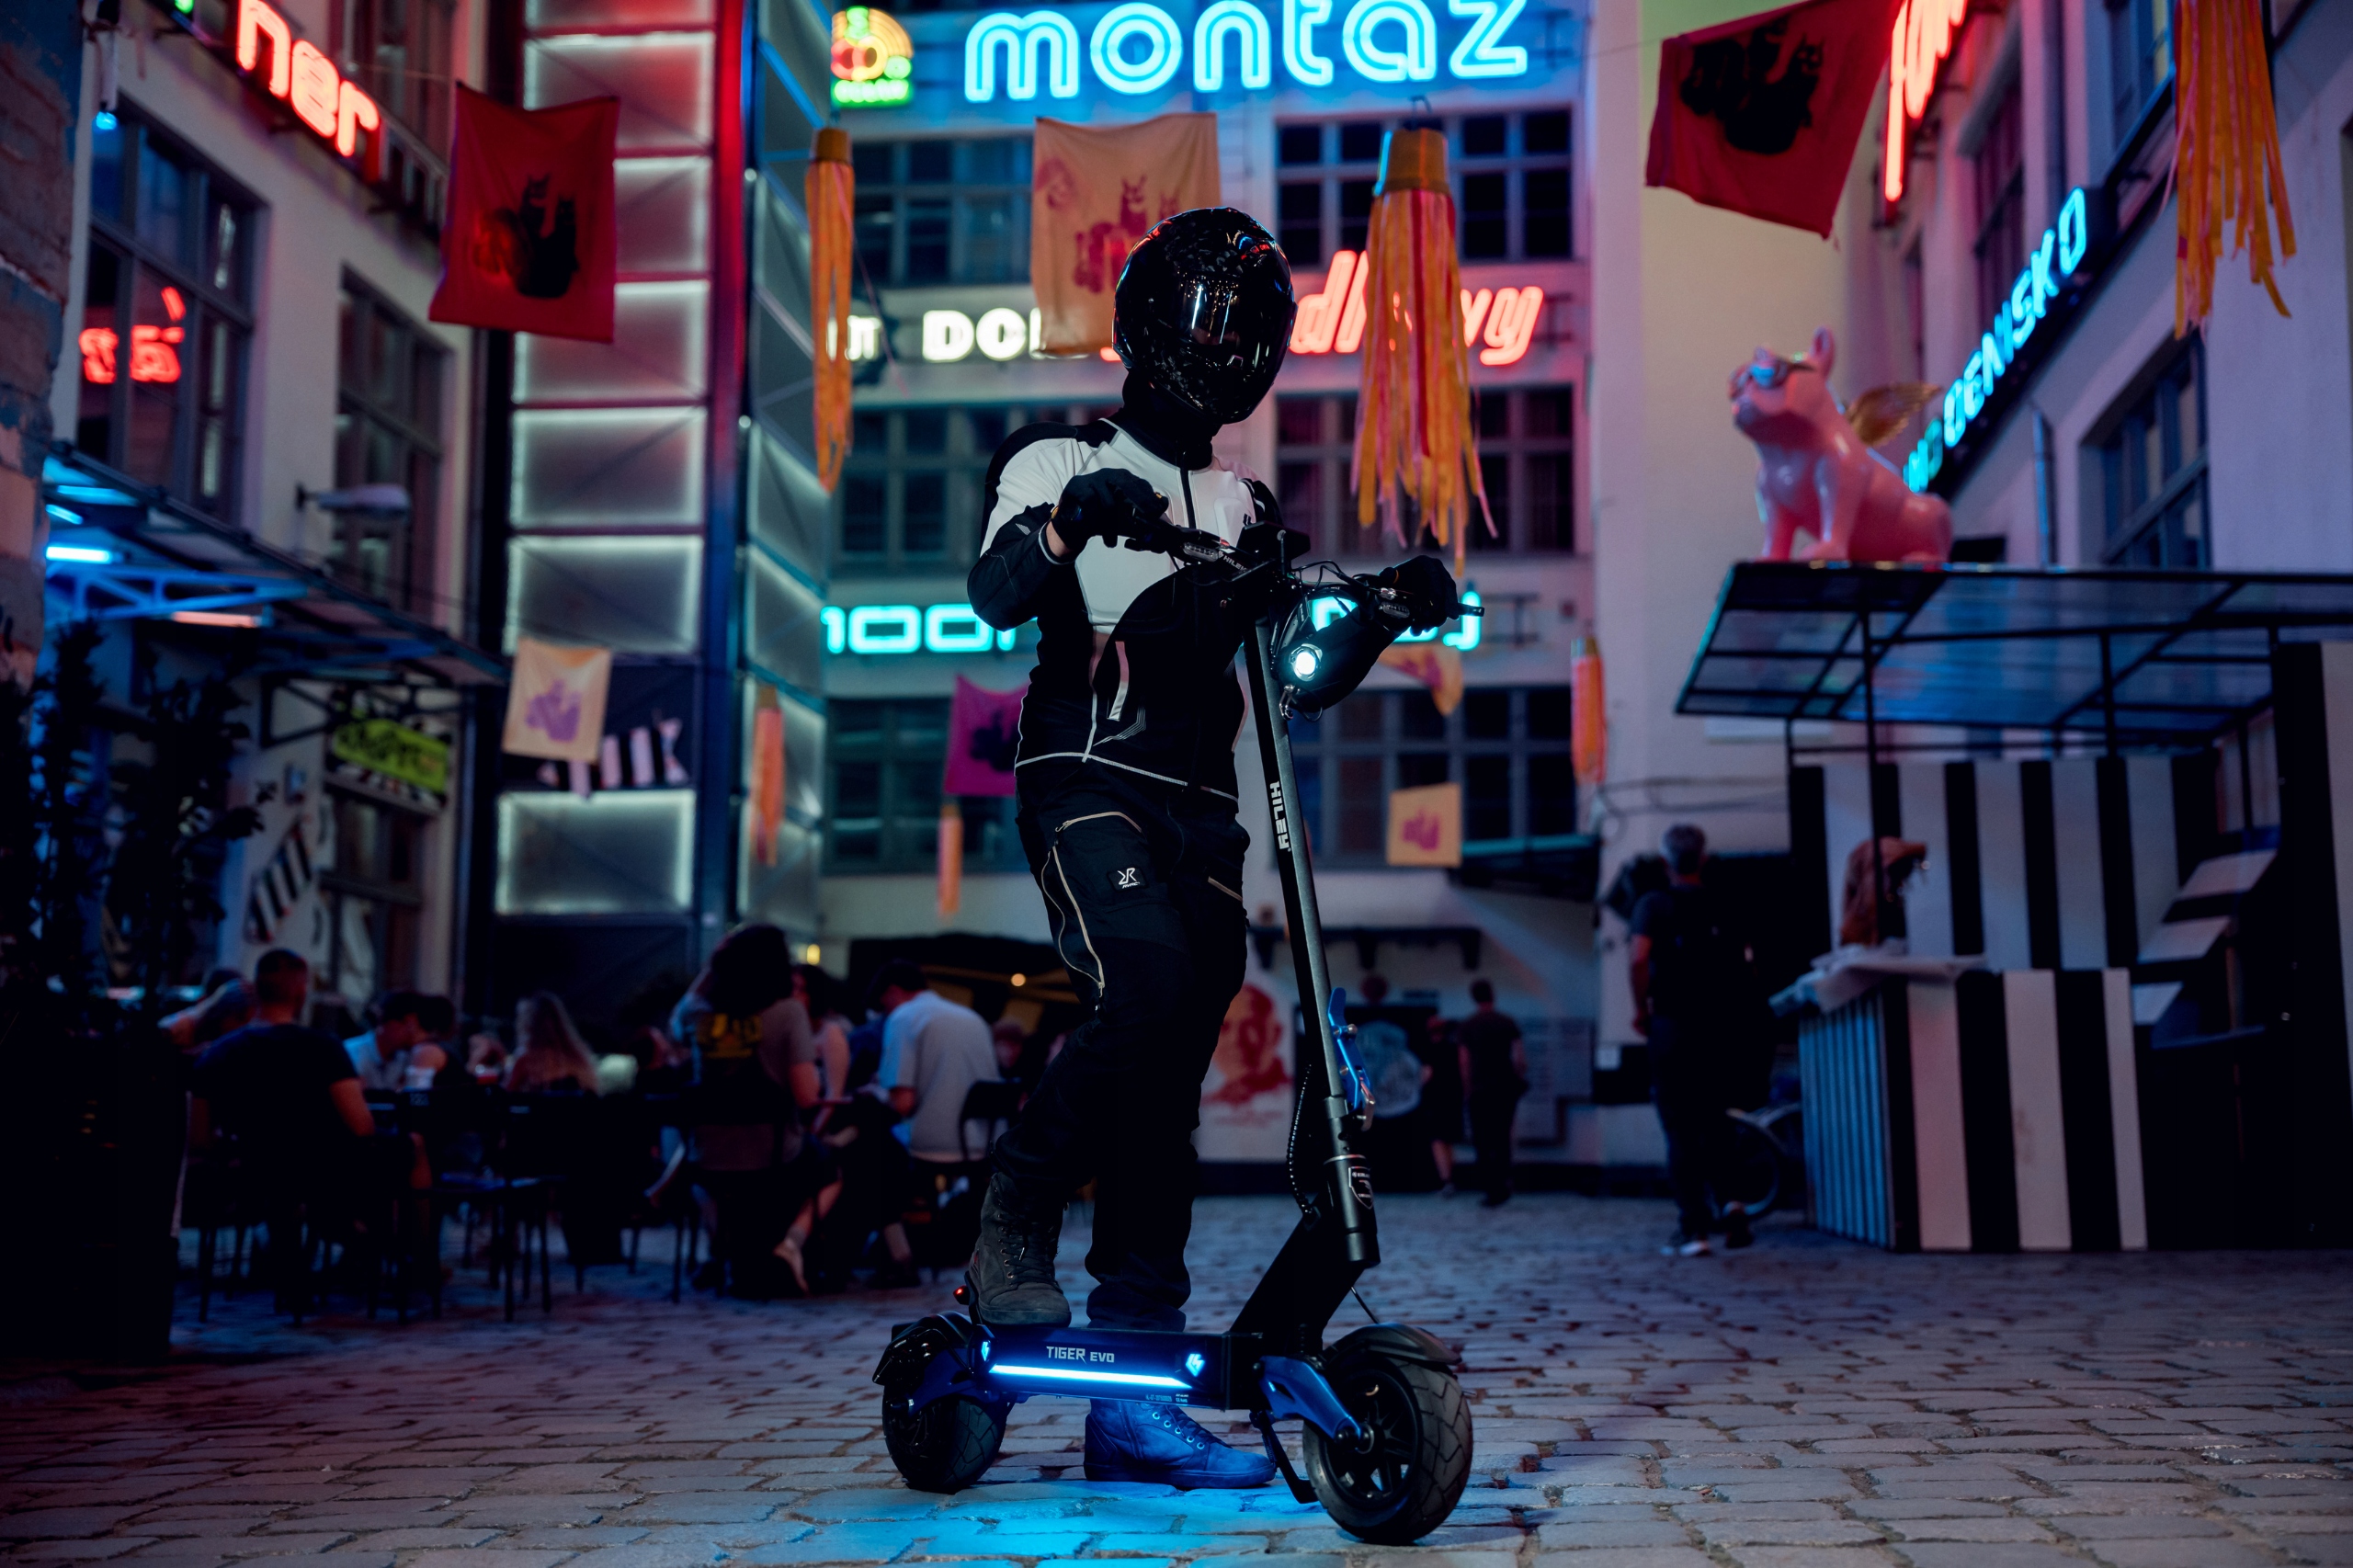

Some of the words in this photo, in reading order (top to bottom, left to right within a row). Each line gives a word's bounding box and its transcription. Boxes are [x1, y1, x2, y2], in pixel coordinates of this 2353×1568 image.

[964, 0, 1529, 102] montaz
[922, 307, 1066, 362] DO
[1269, 780, 1290, 849] HILEY
[1046, 1346, 1086, 1365] TIGER
[1089, 1351, 1115, 1363] EVO
